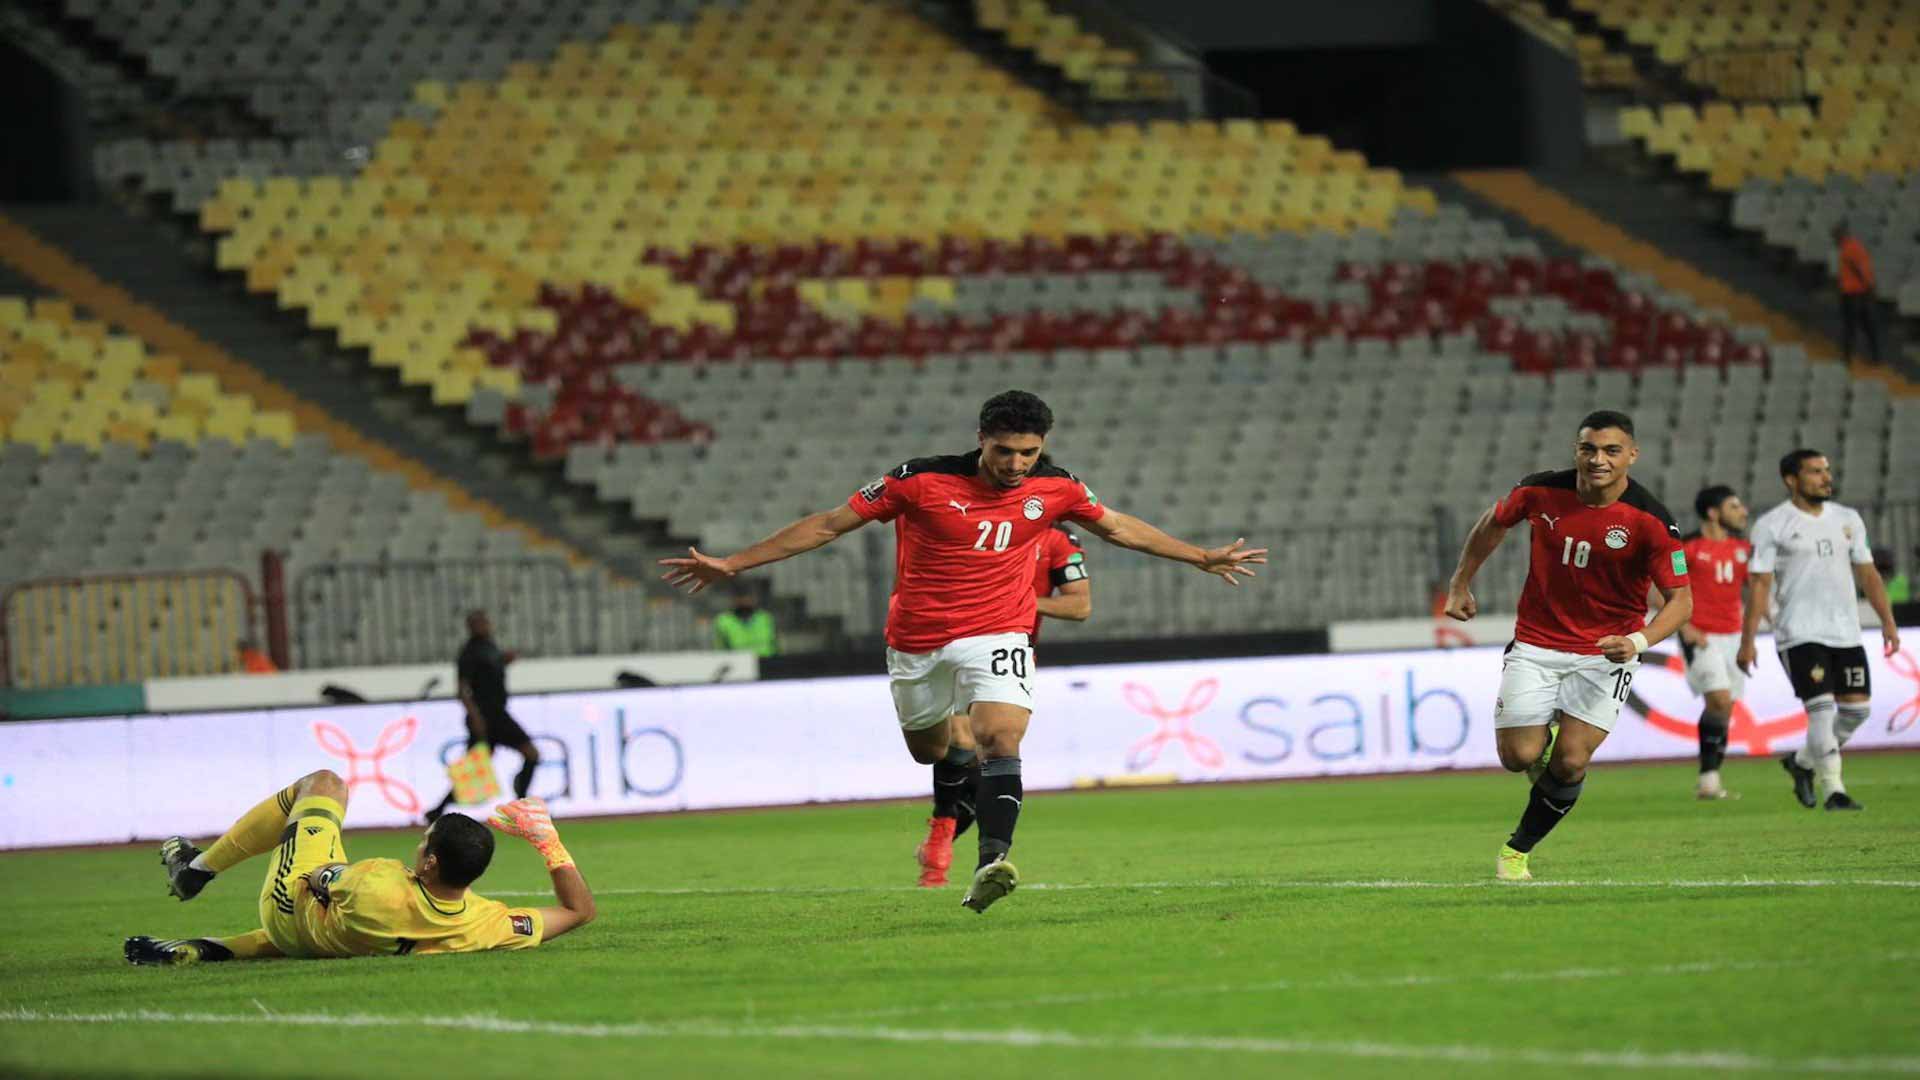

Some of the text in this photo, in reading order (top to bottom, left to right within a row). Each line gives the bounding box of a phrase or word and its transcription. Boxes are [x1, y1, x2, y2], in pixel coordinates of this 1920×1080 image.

[973, 520, 1013, 552] 20
[1562, 536, 1592, 568] 18
[1715, 559, 1734, 584] 14
[991, 647, 1026, 679] 20
[1844, 666, 1866, 687] 13
[1609, 667, 1633, 702] 18
[1239, 670, 1470, 765] saib
